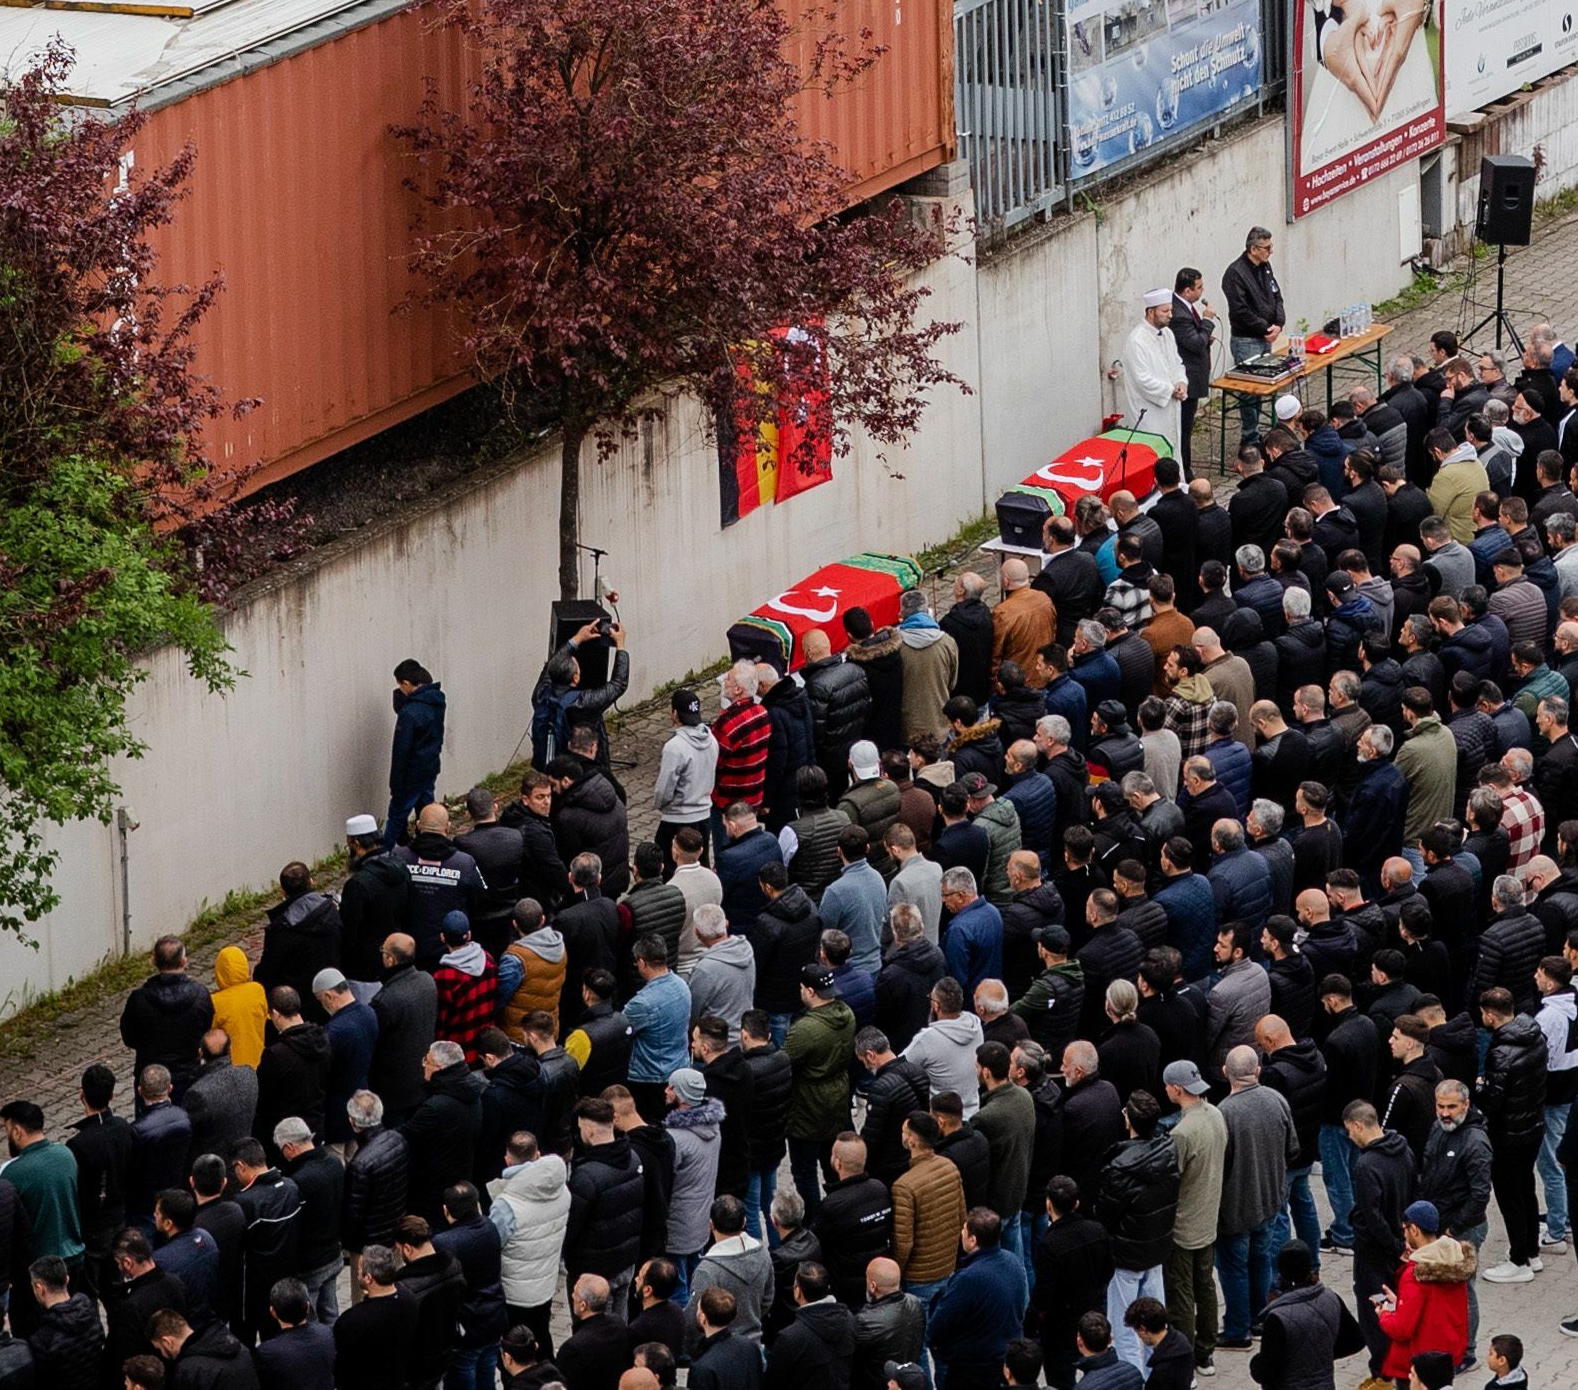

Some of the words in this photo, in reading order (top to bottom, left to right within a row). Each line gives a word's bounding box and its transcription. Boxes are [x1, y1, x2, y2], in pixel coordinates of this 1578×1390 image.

[1173, 45, 1199, 73] Schont
[1200, 37, 1214, 57] die
[1215, 20, 1245, 52] Umwelt
[1172, 74, 1194, 95] nicht
[1194, 65, 1209, 84] den
[1311, 162, 1348, 189] Hochzeiten
[1353, 133, 1403, 167] Veranstaltungen
[1408, 116, 1436, 139] Konzerte
